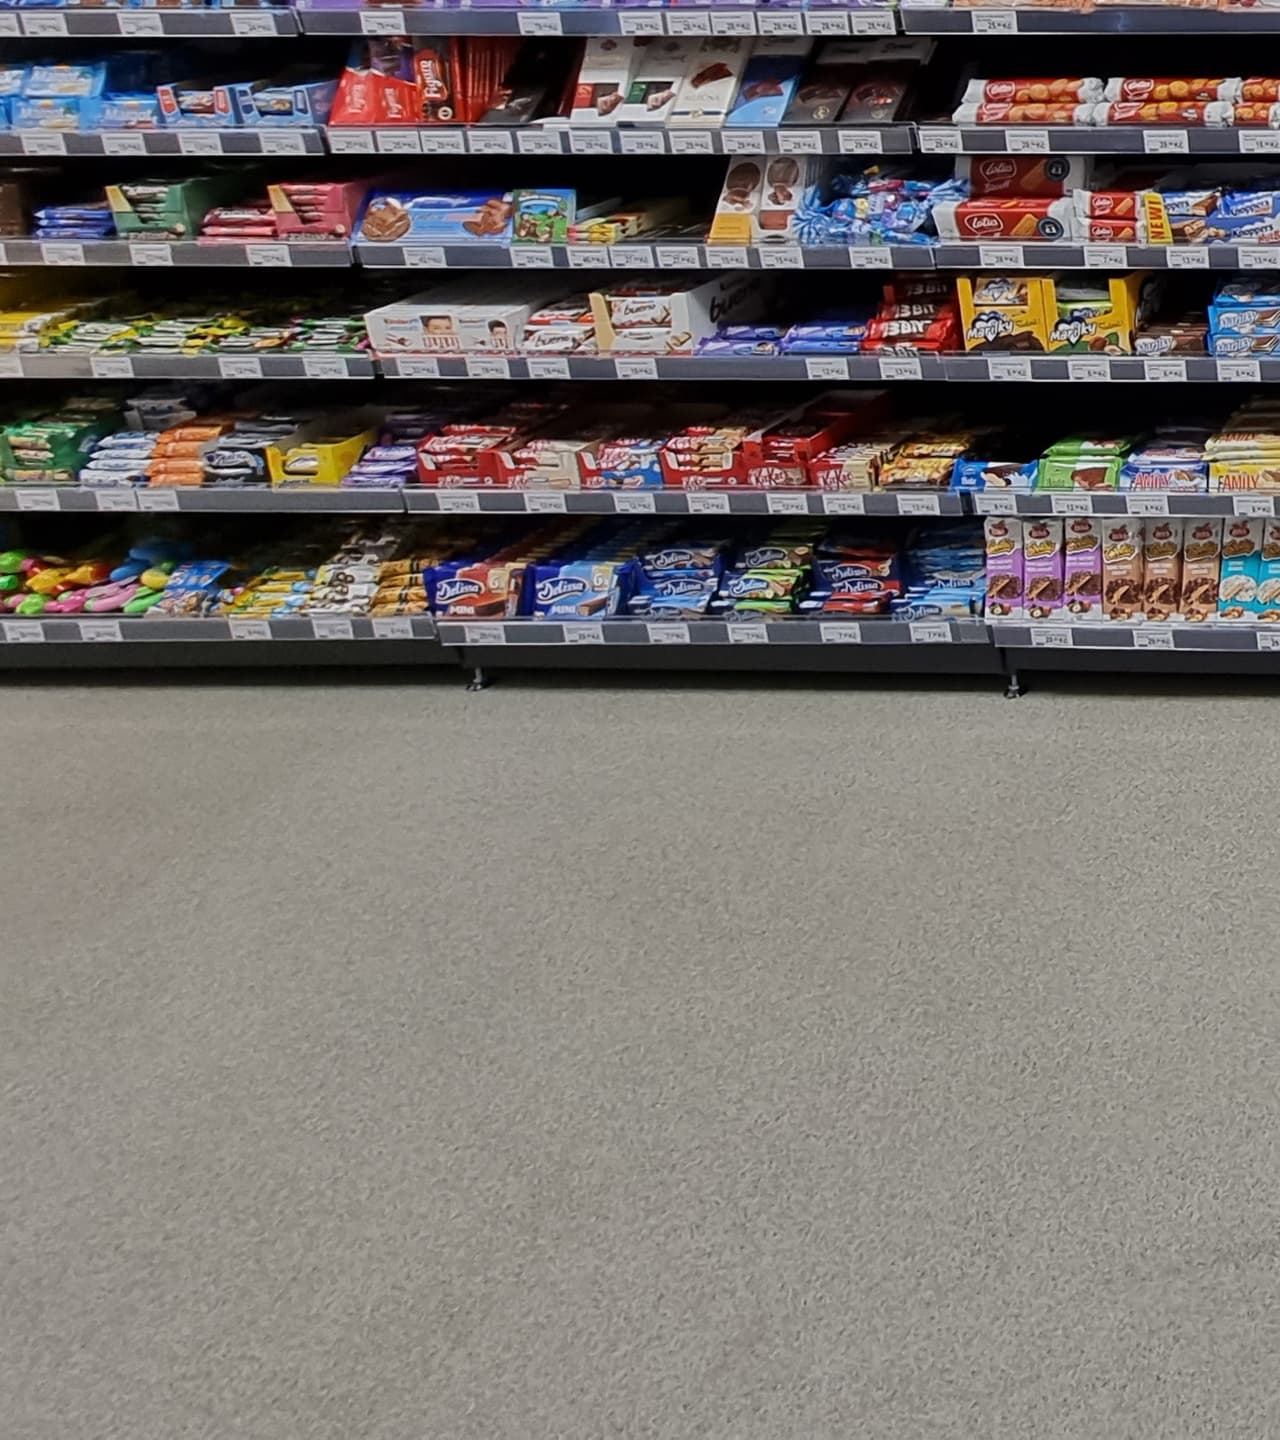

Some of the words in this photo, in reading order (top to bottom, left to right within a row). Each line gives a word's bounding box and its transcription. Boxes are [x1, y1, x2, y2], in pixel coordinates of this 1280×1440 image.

[420, 58, 443, 100] Figaro
[1150, 201, 1164, 242] NEW!
[1232, 224, 1274, 237] Knoppers
[623, 303, 659, 317] bueno
[1049, 320, 1096, 341] Marilky
[436, 579, 483, 601] Delissa
[537, 579, 587, 601] Delissa
